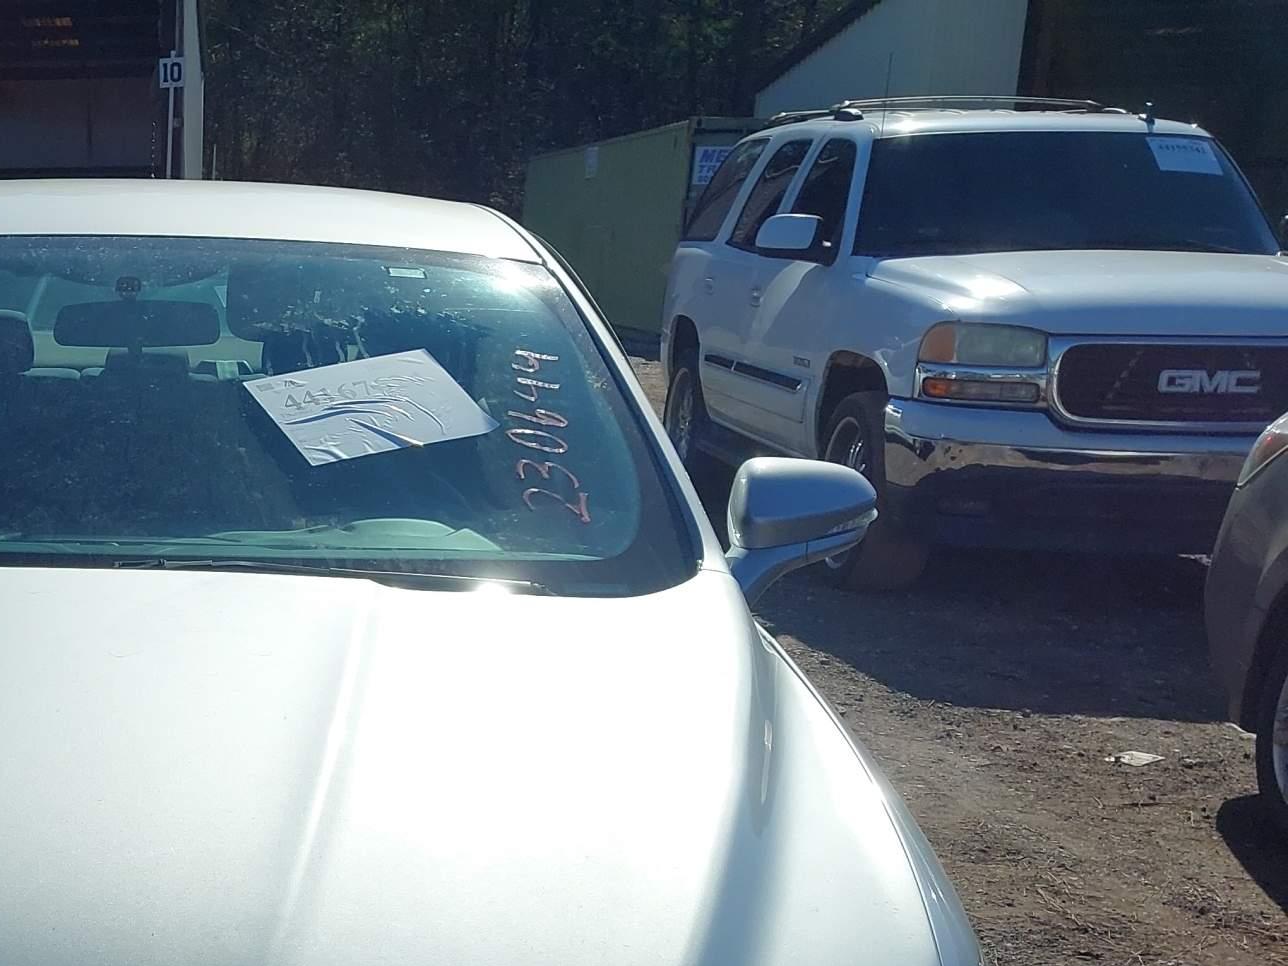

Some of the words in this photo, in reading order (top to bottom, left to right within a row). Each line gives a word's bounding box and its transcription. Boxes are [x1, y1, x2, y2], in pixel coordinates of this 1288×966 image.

[162, 61, 182, 83] 10
[1158, 369, 1261, 394] GMC
[506, 350, 591, 523] 230644
